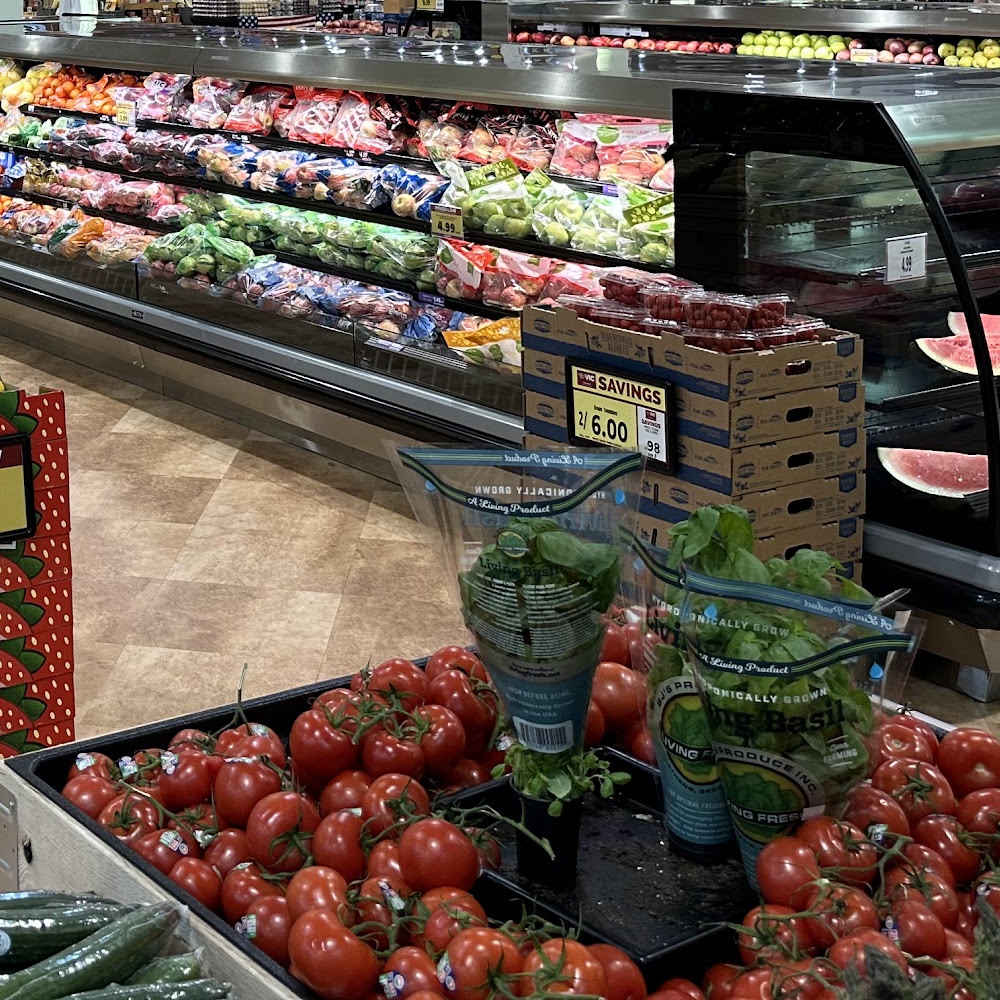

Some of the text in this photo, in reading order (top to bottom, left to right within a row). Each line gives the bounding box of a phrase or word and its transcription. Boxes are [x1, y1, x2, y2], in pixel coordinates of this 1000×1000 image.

[437, 220, 455, 233] 4.99
[585, 374, 662, 405] VIC SAVINGS
[592, 414, 628, 443] 6.00
[467, 497, 550, 515] A Living Product
[479, 557, 521, 578] Living
[753, 622, 790, 638] GROW
[709, 656, 744, 673] Living
[745, 663, 789, 674] Product
[522, 690, 548, 700] BEFORE
[783, 687, 828, 704] GROWN
[766, 699, 846, 734] Basil
[823, 747, 858, 764] FARMING
[714, 744, 817, 796] PRODUCE INC.
[758, 813, 799, 824] FRES
